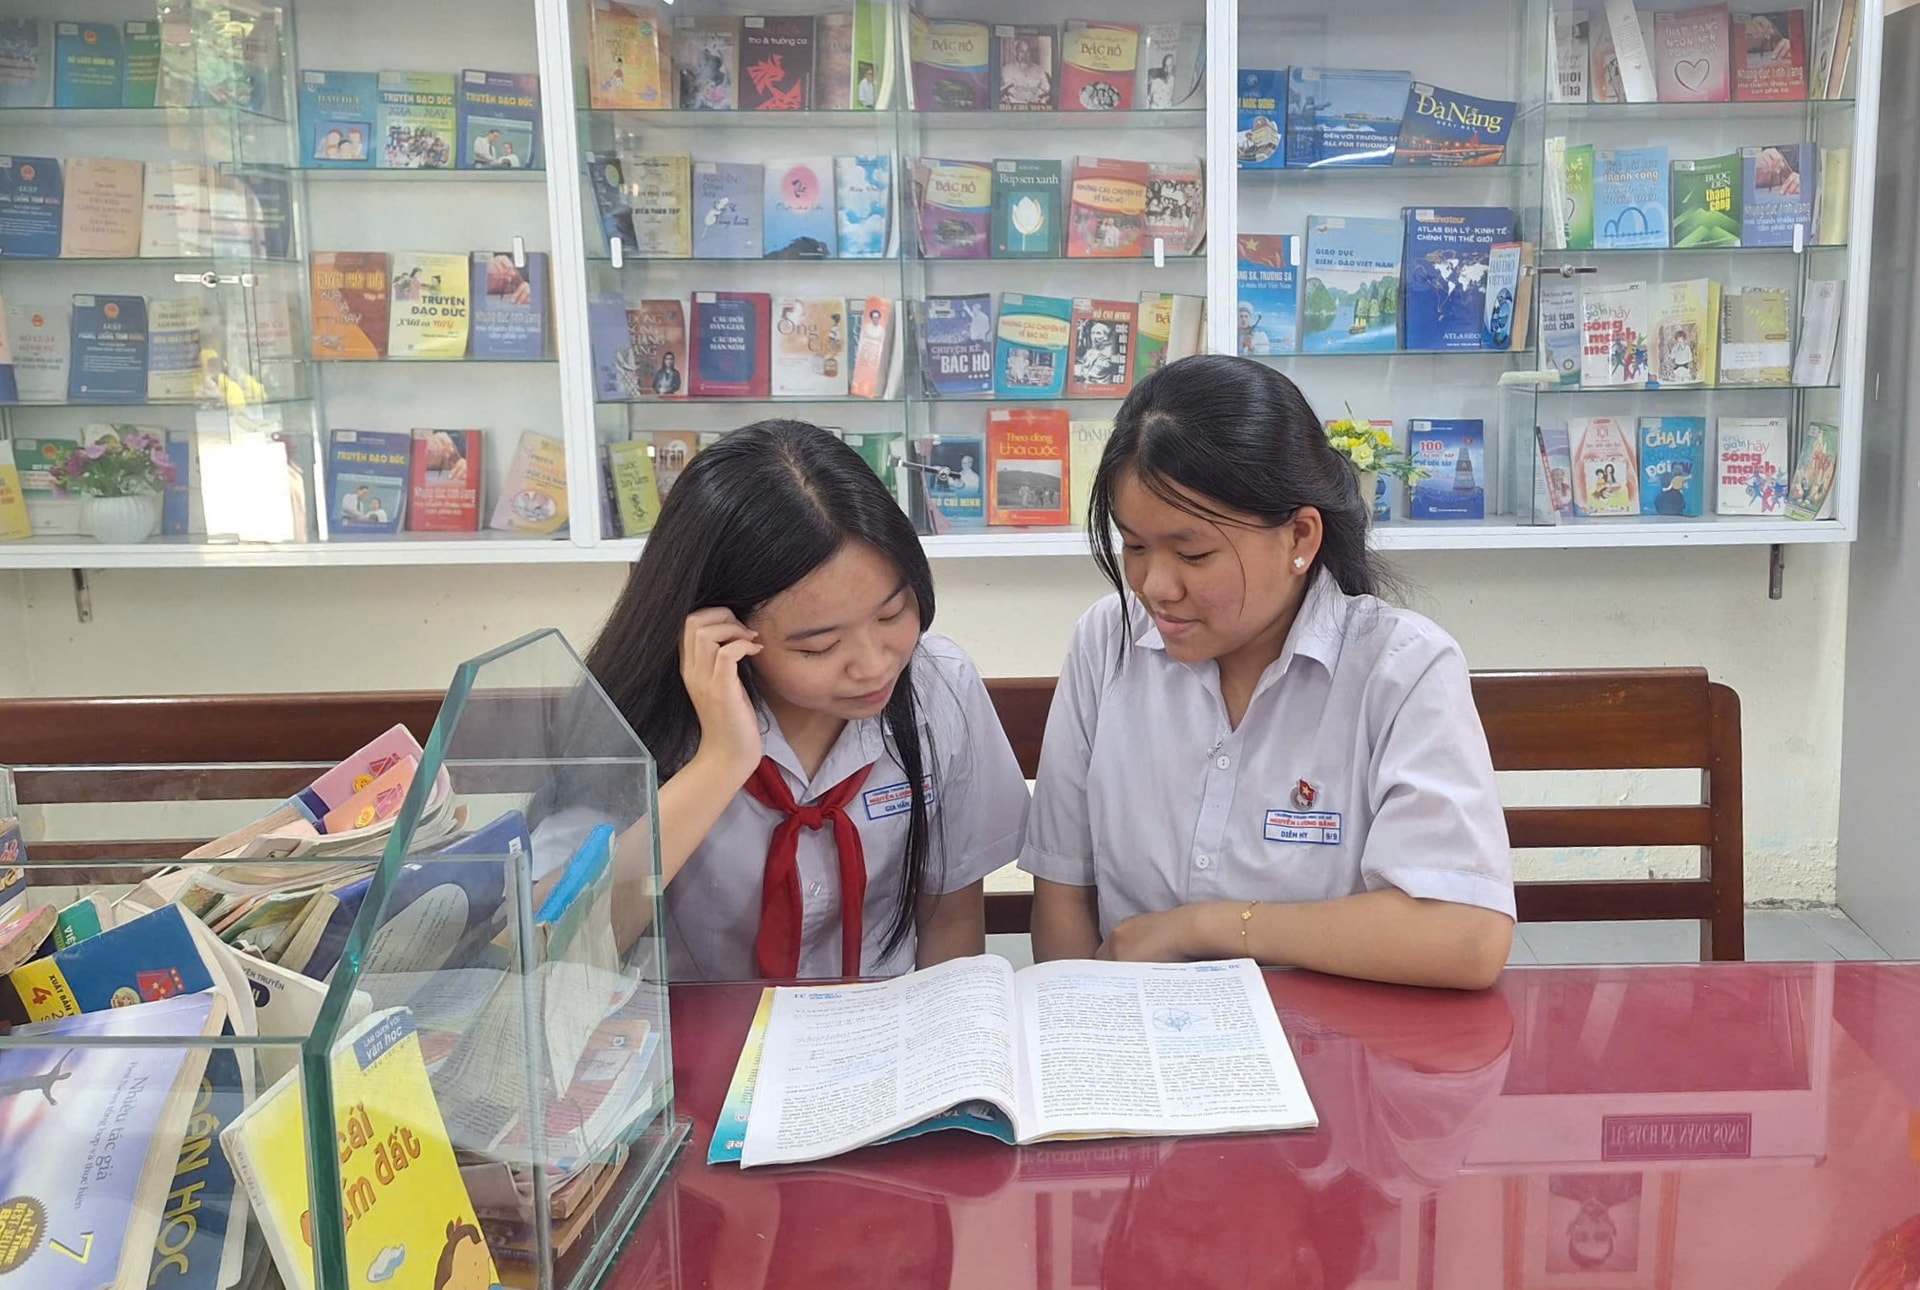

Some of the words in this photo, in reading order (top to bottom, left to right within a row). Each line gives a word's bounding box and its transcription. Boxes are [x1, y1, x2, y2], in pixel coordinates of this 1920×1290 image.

[1416, 94, 1445, 122] Đà
[1446, 101, 1504, 133] Nẵng
[1036, 173, 1059, 184] xanh
[1444, 227, 1458, 235] ĐỊA
[1559, 311, 1575, 321] tim
[1559, 321, 1575, 330] cha
[972, 349, 991, 372] HỒ
[1006, 432, 1028, 441] Theo
[1419, 440, 1444, 451] 100
[1024, 445, 1059, 456] cuộc
[1721, 450, 1762, 464] sống
[897, 800, 910, 810] HÂN
[1269, 817, 1295, 826] NGUYỄN
[1326, 832, 1338, 840] 9/9
[257, 973, 286, 991] TRUYỀN
[32, 986, 52, 1006] 4
[48, 975, 63, 994] XUẤT
[60, 994, 72, 1011] BẢN
[121, 1074, 150, 1124] Nhiều
[104, 1126, 126, 1152] tác
[375, 1125, 421, 1186] đất
[96, 1152, 115, 1182] giả
[18, 1207, 35, 1232] ALL
[20, 1223, 38, 1249] THE
[4, 1233, 25, 1265] TIME
[49, 1230, 95, 1265] 7
